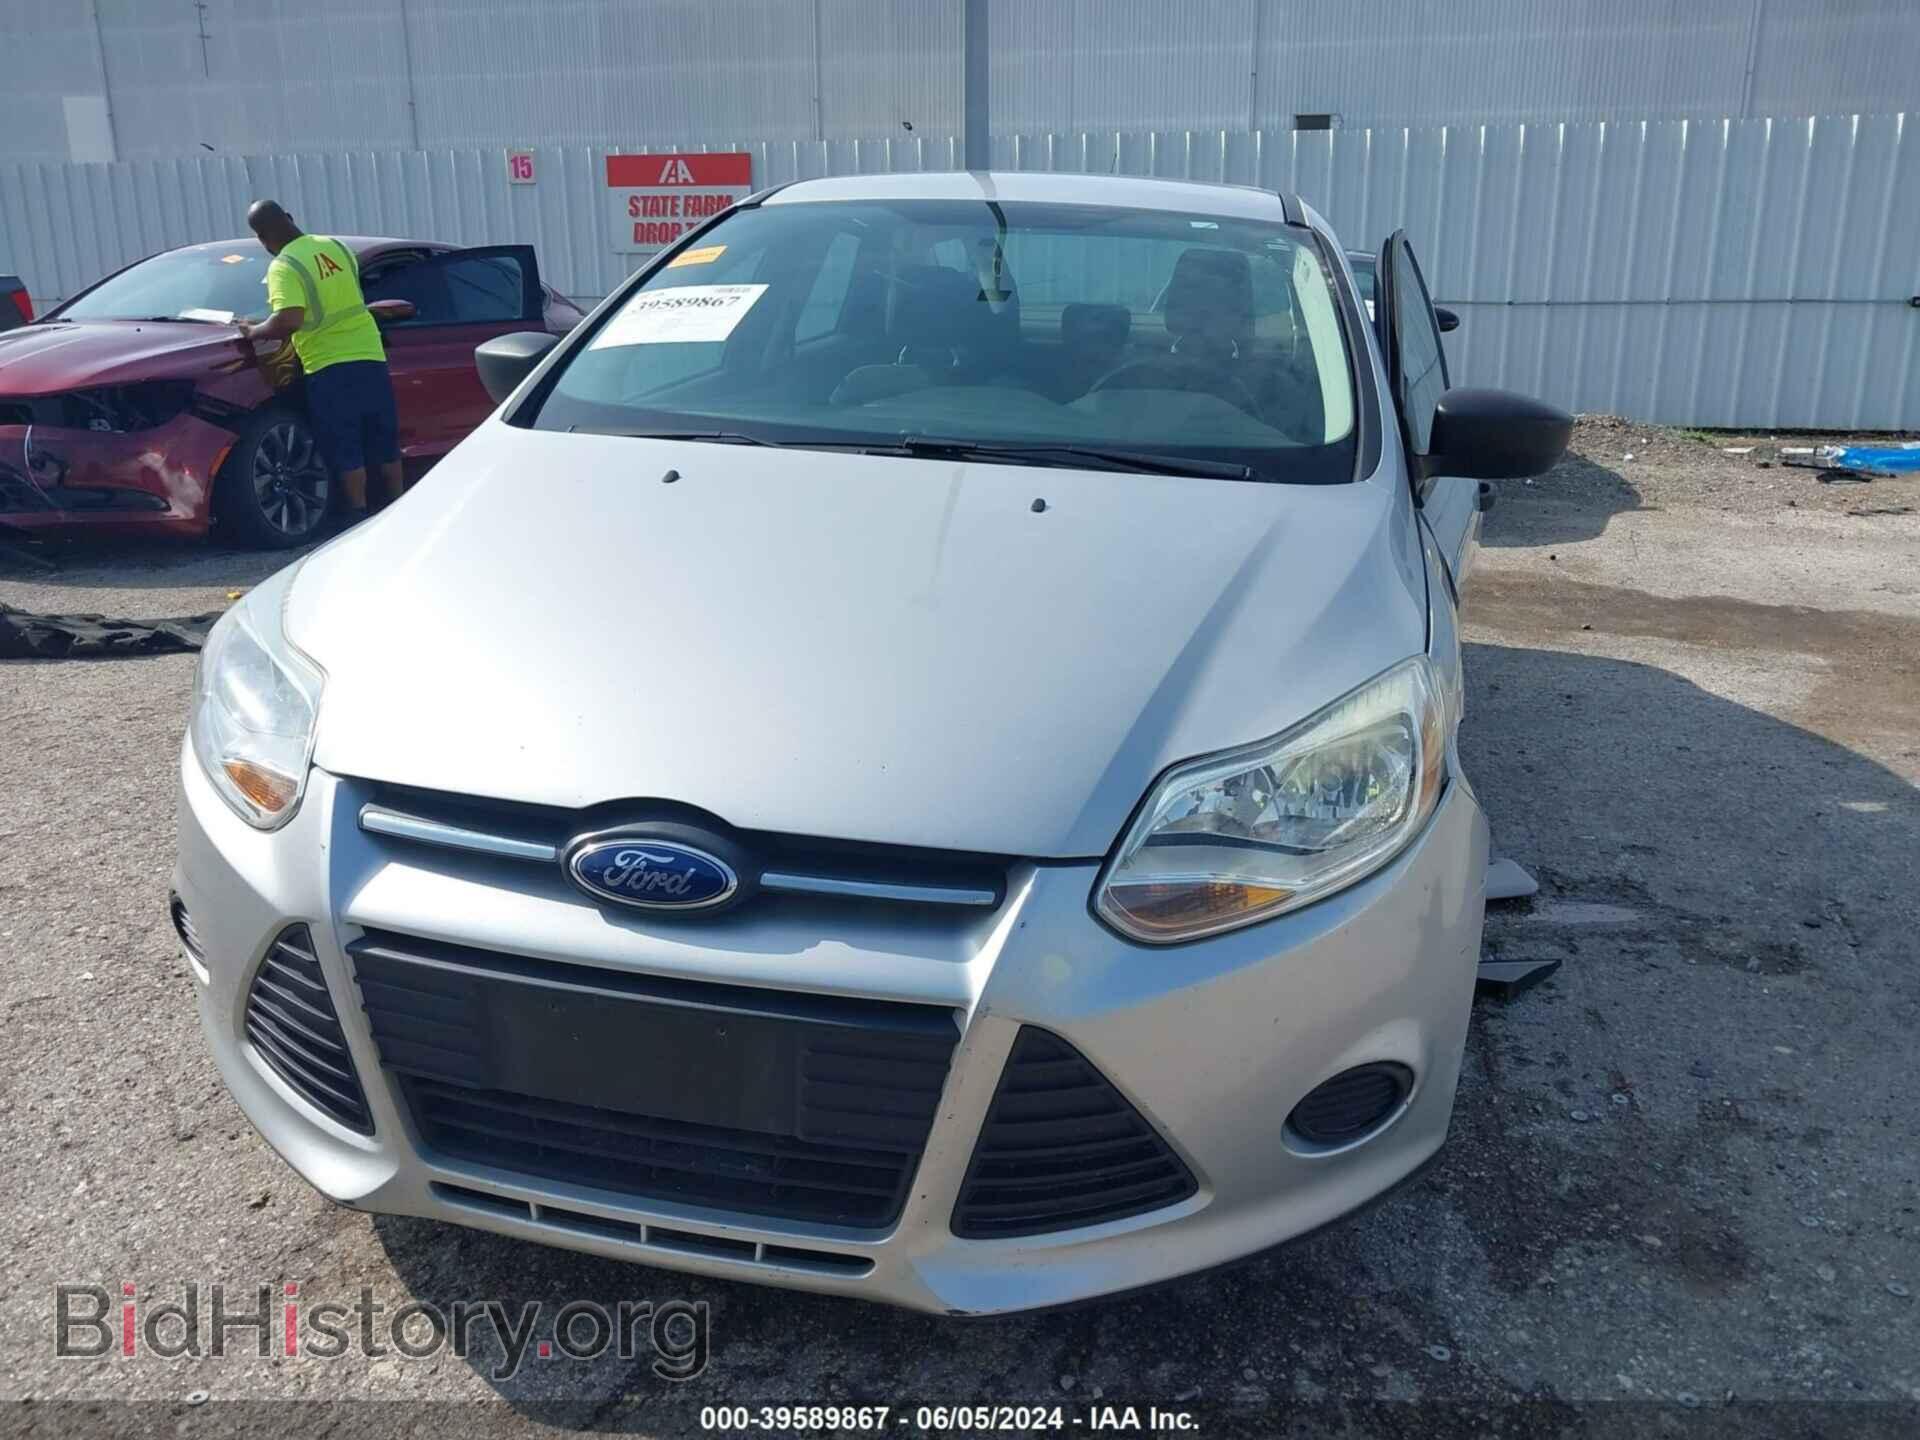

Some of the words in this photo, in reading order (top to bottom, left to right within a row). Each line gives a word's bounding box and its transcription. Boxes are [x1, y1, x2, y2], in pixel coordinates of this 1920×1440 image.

[510, 155, 532, 179] 15
[628, 194, 681, 218] STATE
[683, 194, 734, 217] FARM
[633, 222, 683, 244] DROP
[603, 850, 697, 895] Ford
